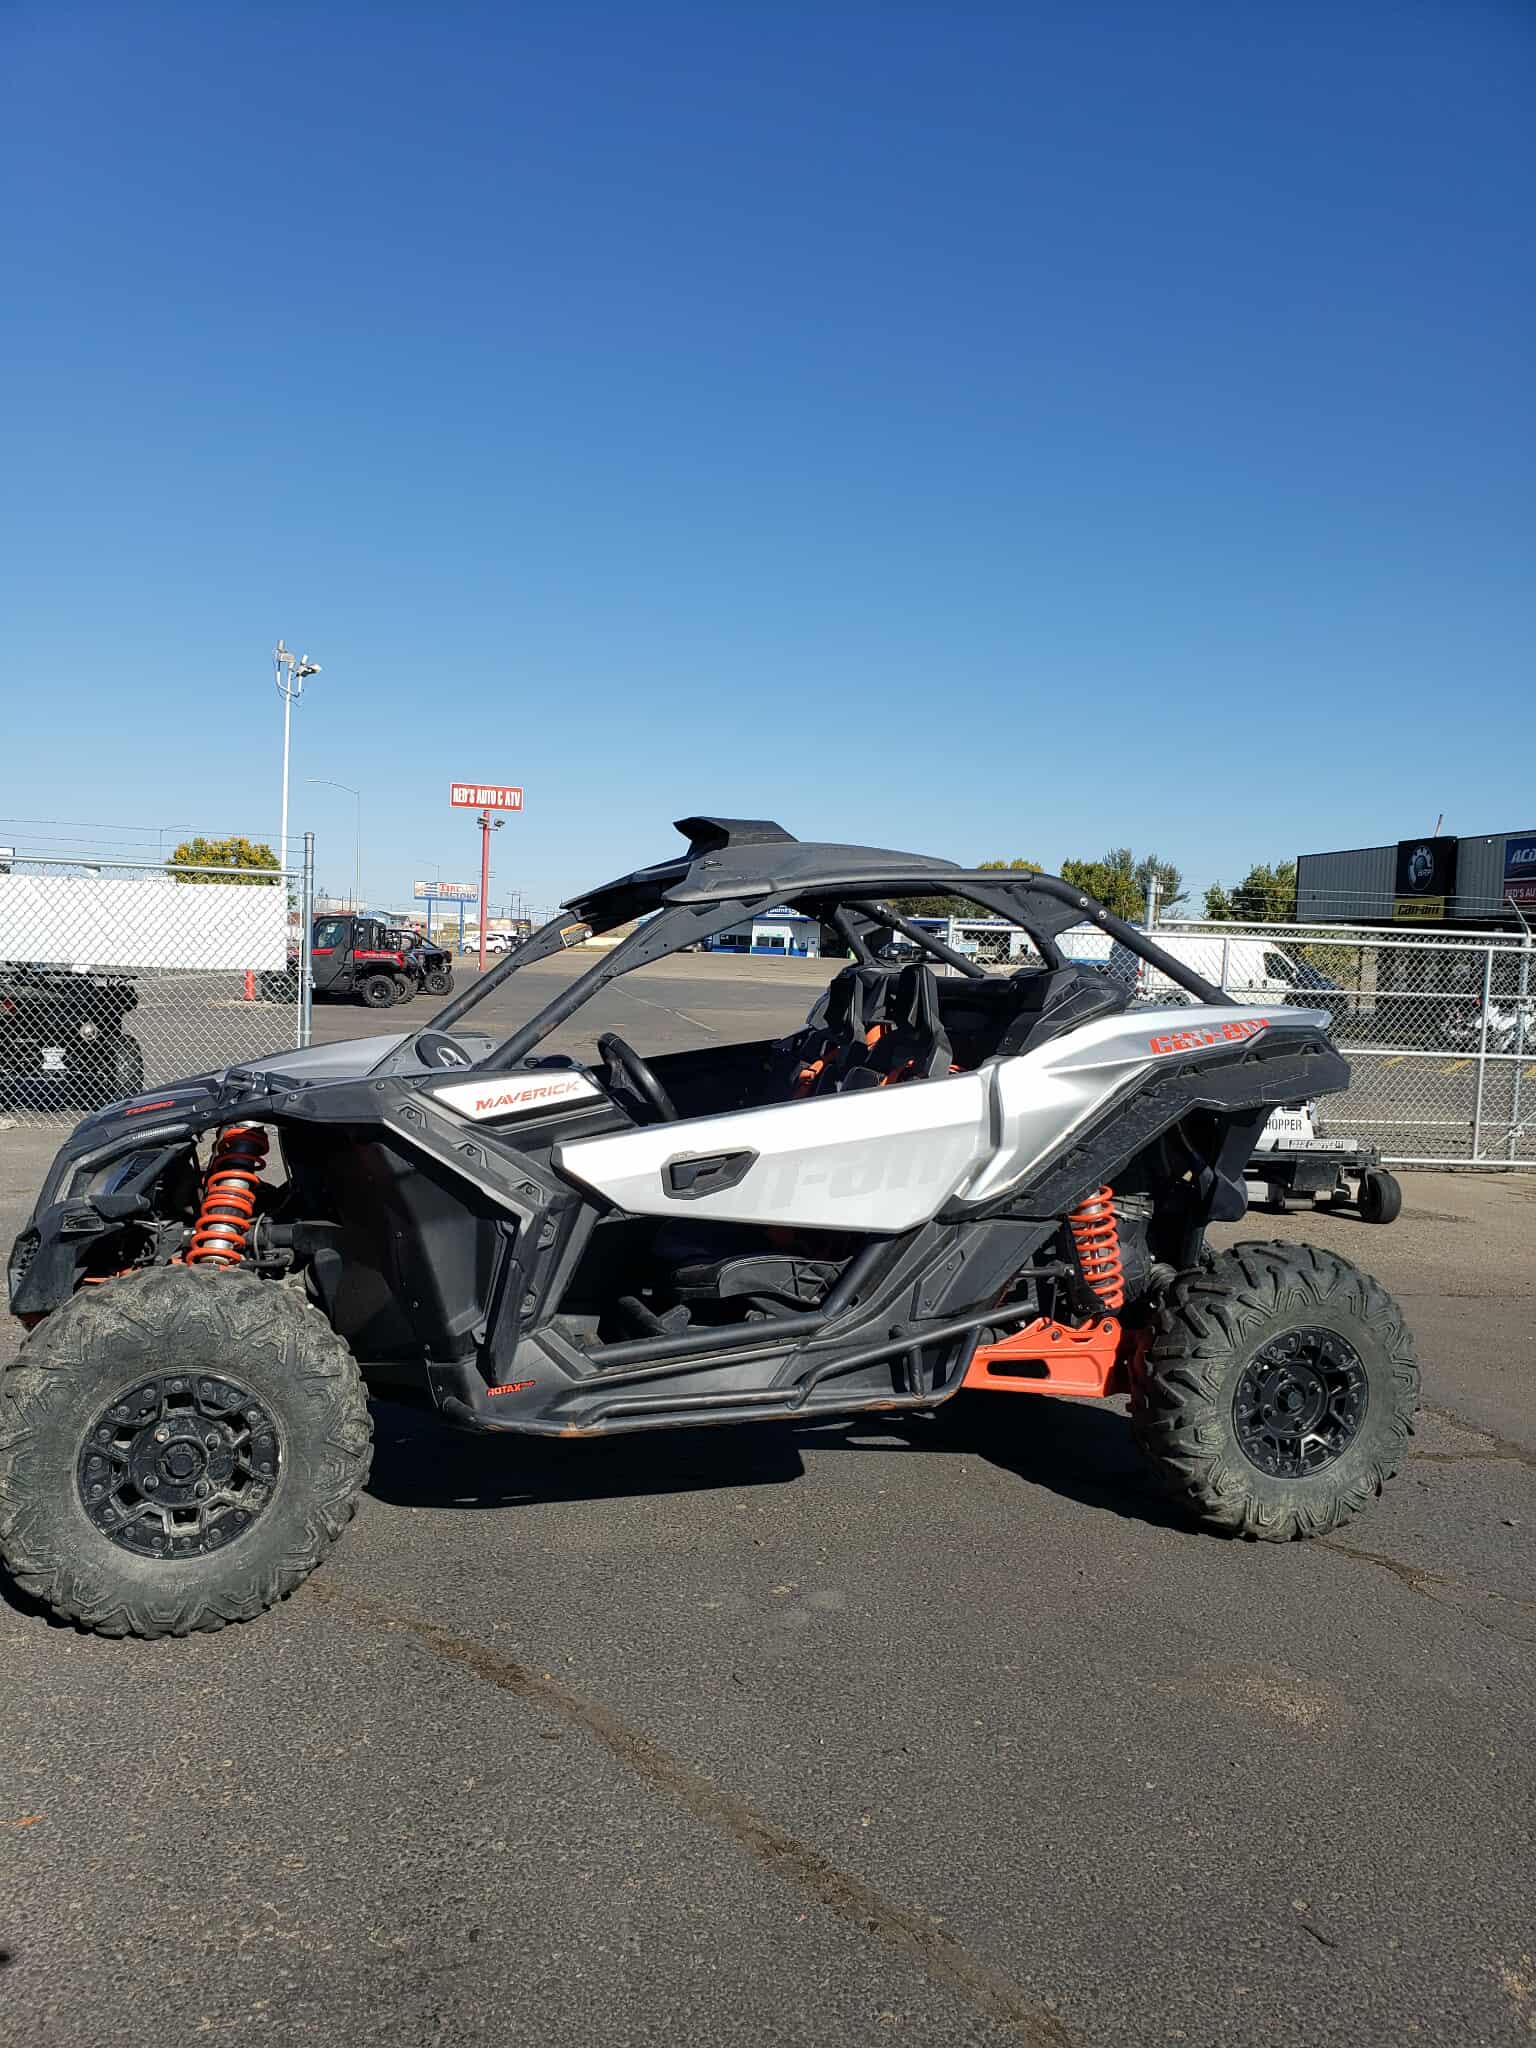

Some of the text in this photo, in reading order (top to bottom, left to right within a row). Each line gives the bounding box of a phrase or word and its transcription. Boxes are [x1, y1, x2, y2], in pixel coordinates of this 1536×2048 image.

[453, 787, 475, 803] RED'S
[476, 789, 497, 805] AUTO
[505, 791, 521, 807] ATV
[475, 1081, 580, 1111] MAVERICK
[487, 1383, 521, 1397] ROTAX
